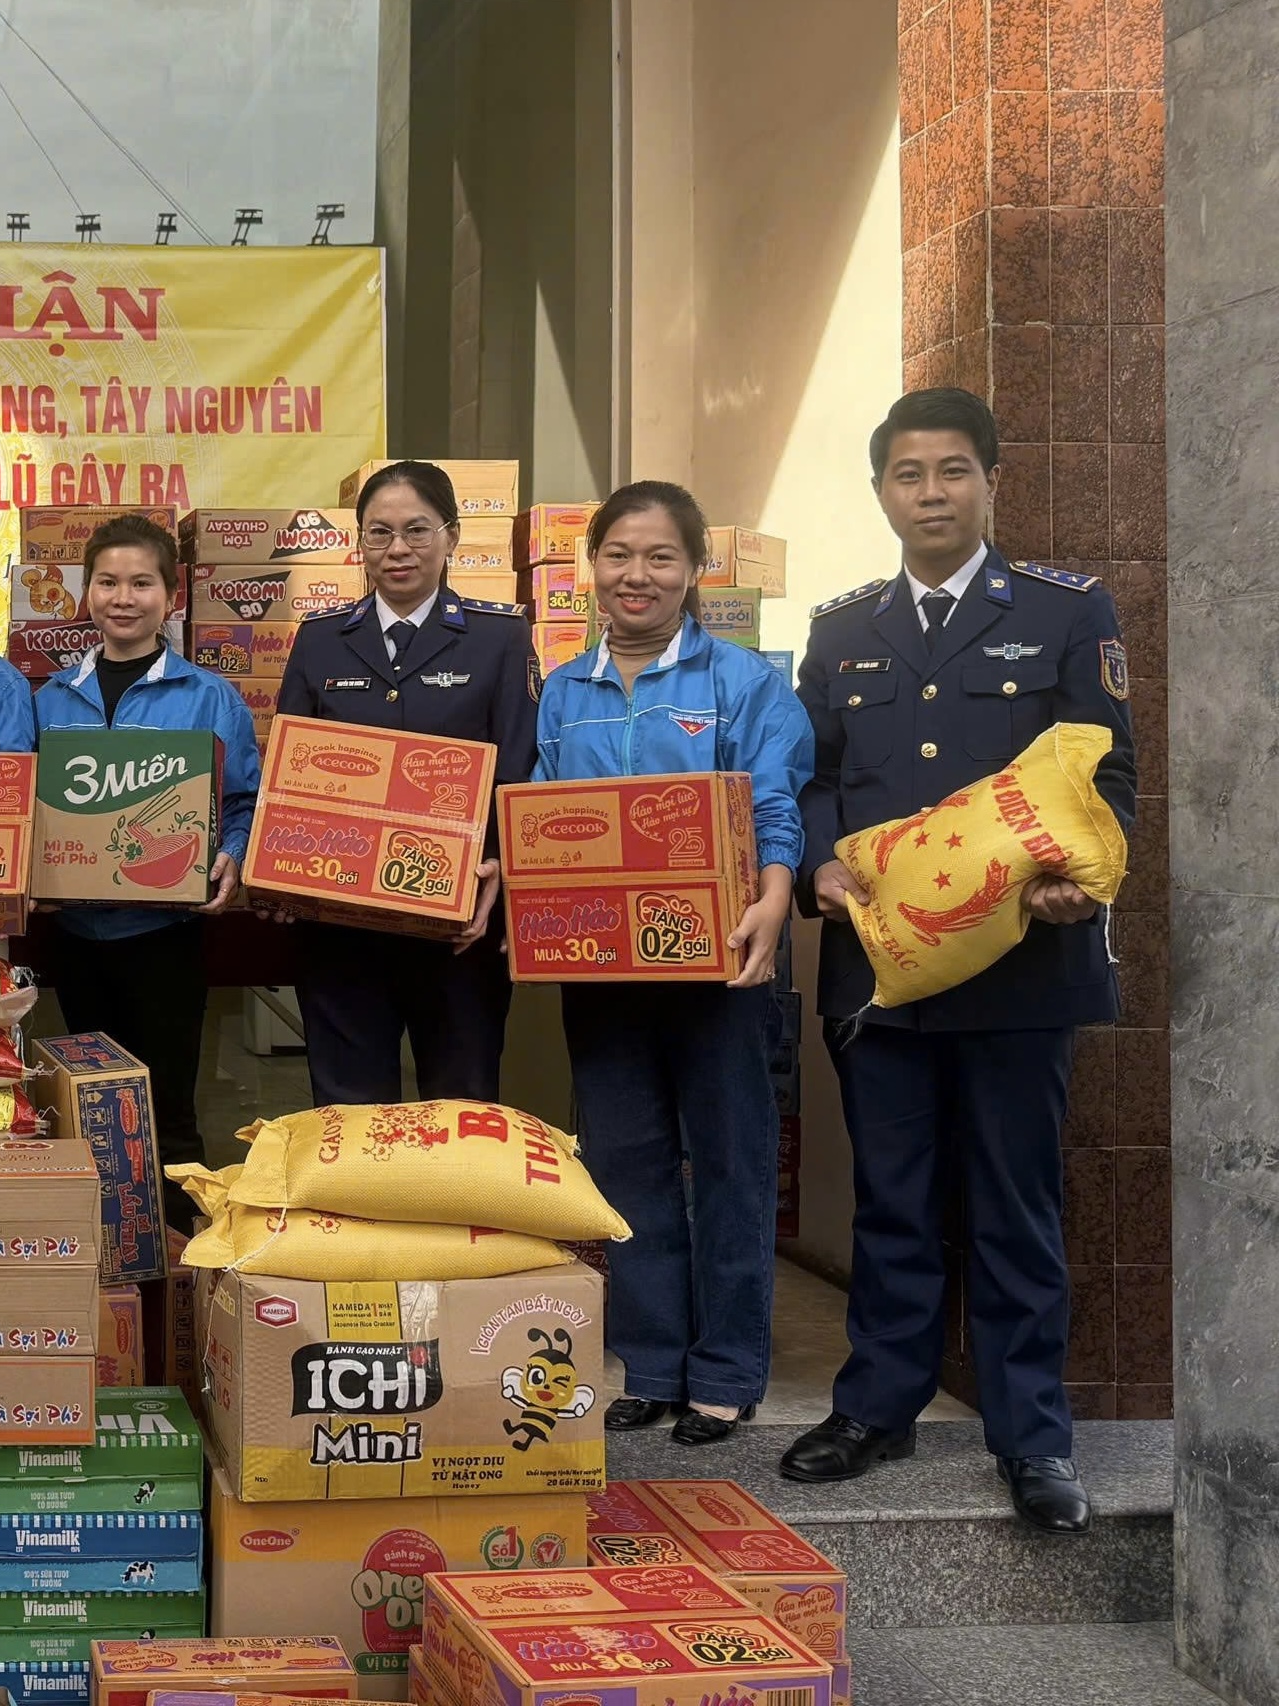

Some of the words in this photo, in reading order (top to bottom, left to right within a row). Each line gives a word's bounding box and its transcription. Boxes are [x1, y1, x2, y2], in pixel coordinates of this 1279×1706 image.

[80, 376, 151, 433] TÂY
[165, 376, 321, 433] NGUYÊN
[51, 453, 127, 506] GÂY
[141, 463, 191, 510] RA
[208, 521, 231, 532] CAY
[234, 521, 268, 532] CHUA
[223, 534, 252, 548] TÔM
[276, 530, 350, 549] KOKOMI
[209, 582, 285, 601] KOKOMI
[310, 583, 337, 596] TÔM
[239, 602, 263, 618] 90
[727, 611, 749, 621] GÓI
[59, 652, 82, 667] 90
[63, 755, 99, 805] 3
[95, 752, 188, 803] Miền
[430, 783, 468, 810] 25
[539, 808, 561, 820] Cook
[562, 806, 609, 819] happiness
[44, 840, 60, 850] Mì
[65, 839, 84, 850] Bò
[43, 852, 66, 866] Sợi
[69, 850, 98, 865] Phở
[399, 844, 439, 873] TẶNG
[650, 906, 692, 933] TẶNG
[534, 948, 563, 962] MUA
[564, 938, 598, 961] 30
[596, 948, 617, 964] gói
[10, 1237, 38, 1259] Sợi
[43, 1236, 79, 1257] Phở
[497, 1300, 523, 1322] TAN
[525, 1294, 551, 1311] BẤT
[9, 1328, 37, 1350] Sợi
[42, 1328, 78, 1348] Phở
[326, 1345, 355, 1354] BÁNH
[356, 1346, 375, 1356] GẠO
[376, 1346, 403, 1355] NHẬT
[12, 1404, 41, 1427] Sợi
[45, 1404, 82, 1424] Phở
[313, 1422, 421, 1463] Mini
[432, 1457, 446, 1467] VỊ
[448, 1457, 481, 1466] NGỌT
[483, 1456, 505, 1467] DỊU
[432, 1470, 450, 1480] TỪ
[452, 1469, 477, 1482] MẬT
[479, 1471, 503, 1479] ONG
[559, 1478, 572, 1486] Gói
[15, 1530, 80, 1546] Vinamilk
[243, 1535, 292, 1548] OneOne
[23, 1600, 87, 1617] Vinamilk
[366, 1657, 378, 1670] Vị
[383, 1656, 398, 1668] bò
[550, 1661, 595, 1673] MUA
[23, 1674, 87, 1691] Vinamilk
